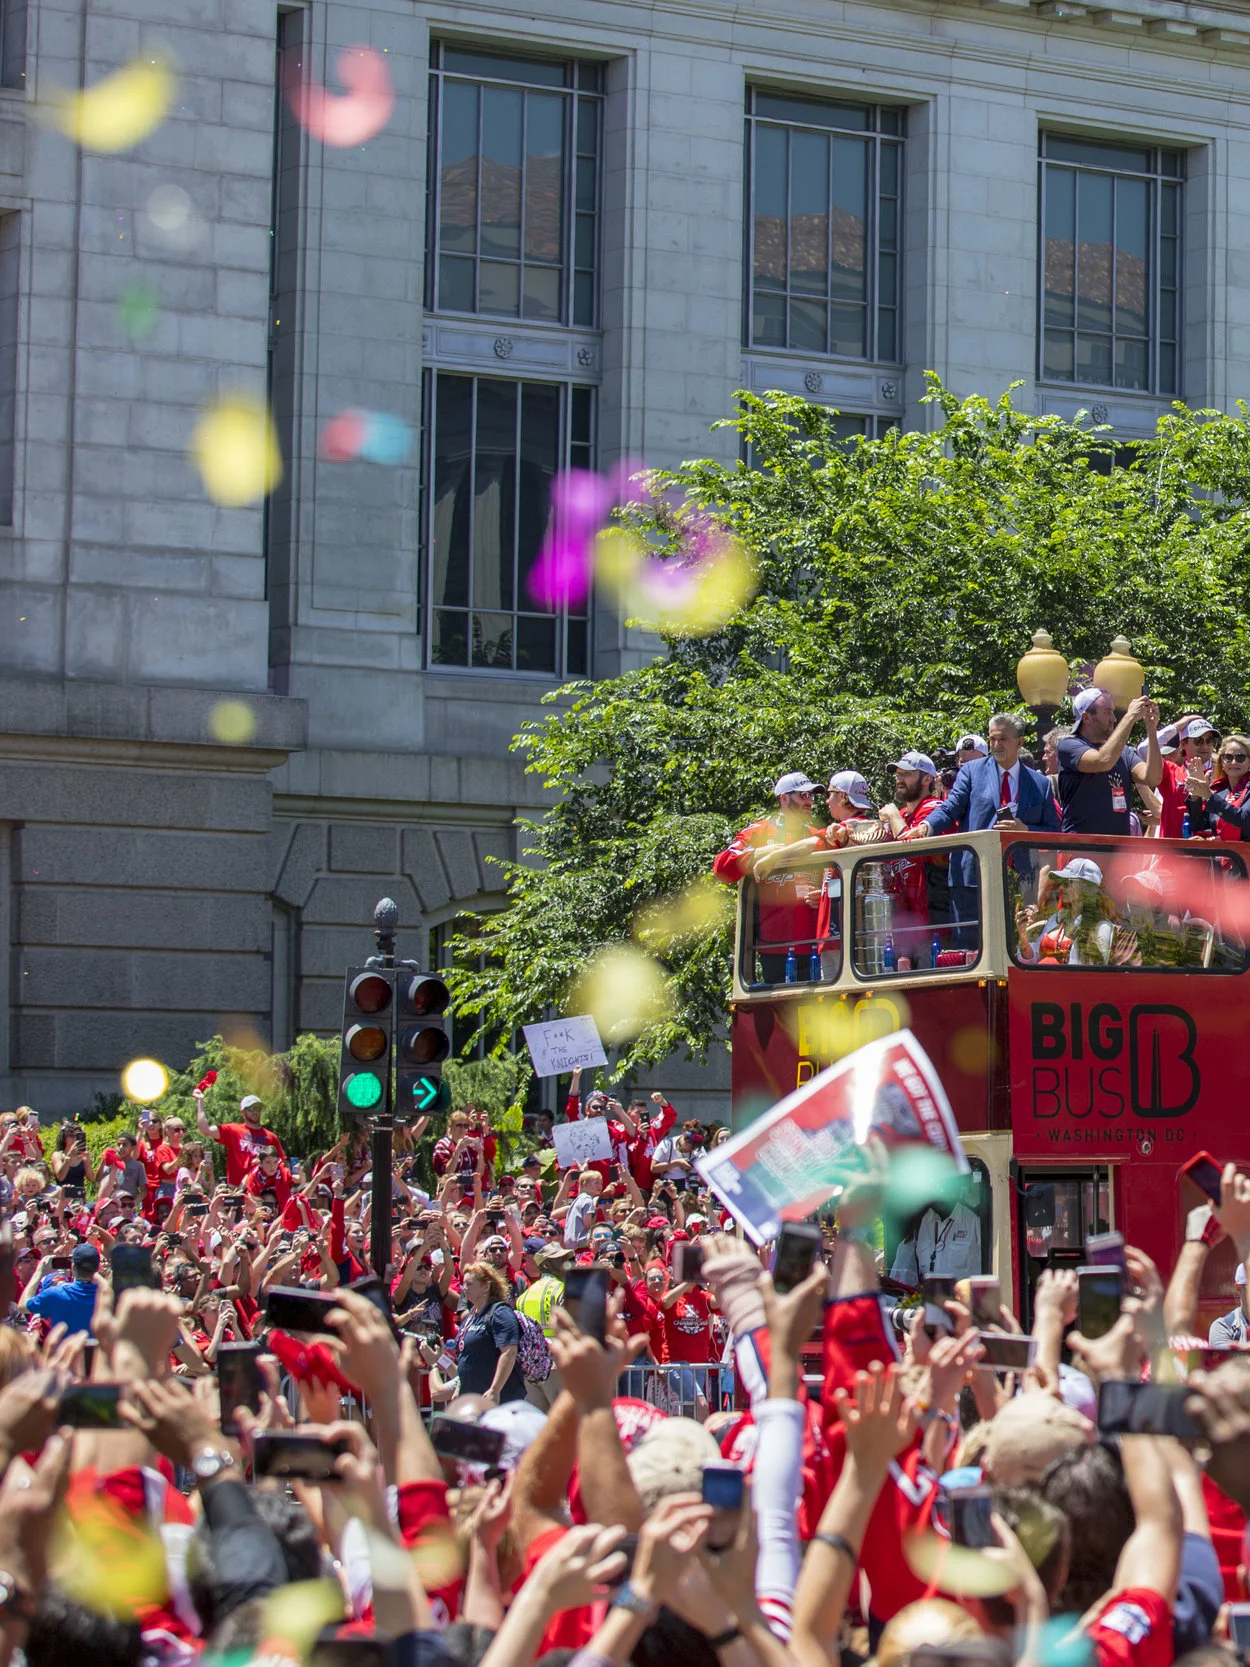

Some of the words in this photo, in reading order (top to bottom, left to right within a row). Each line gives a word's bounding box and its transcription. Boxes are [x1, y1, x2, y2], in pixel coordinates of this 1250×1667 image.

[1031, 1002, 1124, 1060] BIG
[551, 1045, 568, 1054] THE
[551, 1053, 593, 1070] KNIGHTS!
[1032, 1067, 1125, 1118] BUS
[1048, 1128, 1157, 1142] WASHINGTON
[1165, 1128, 1185, 1142] DC
